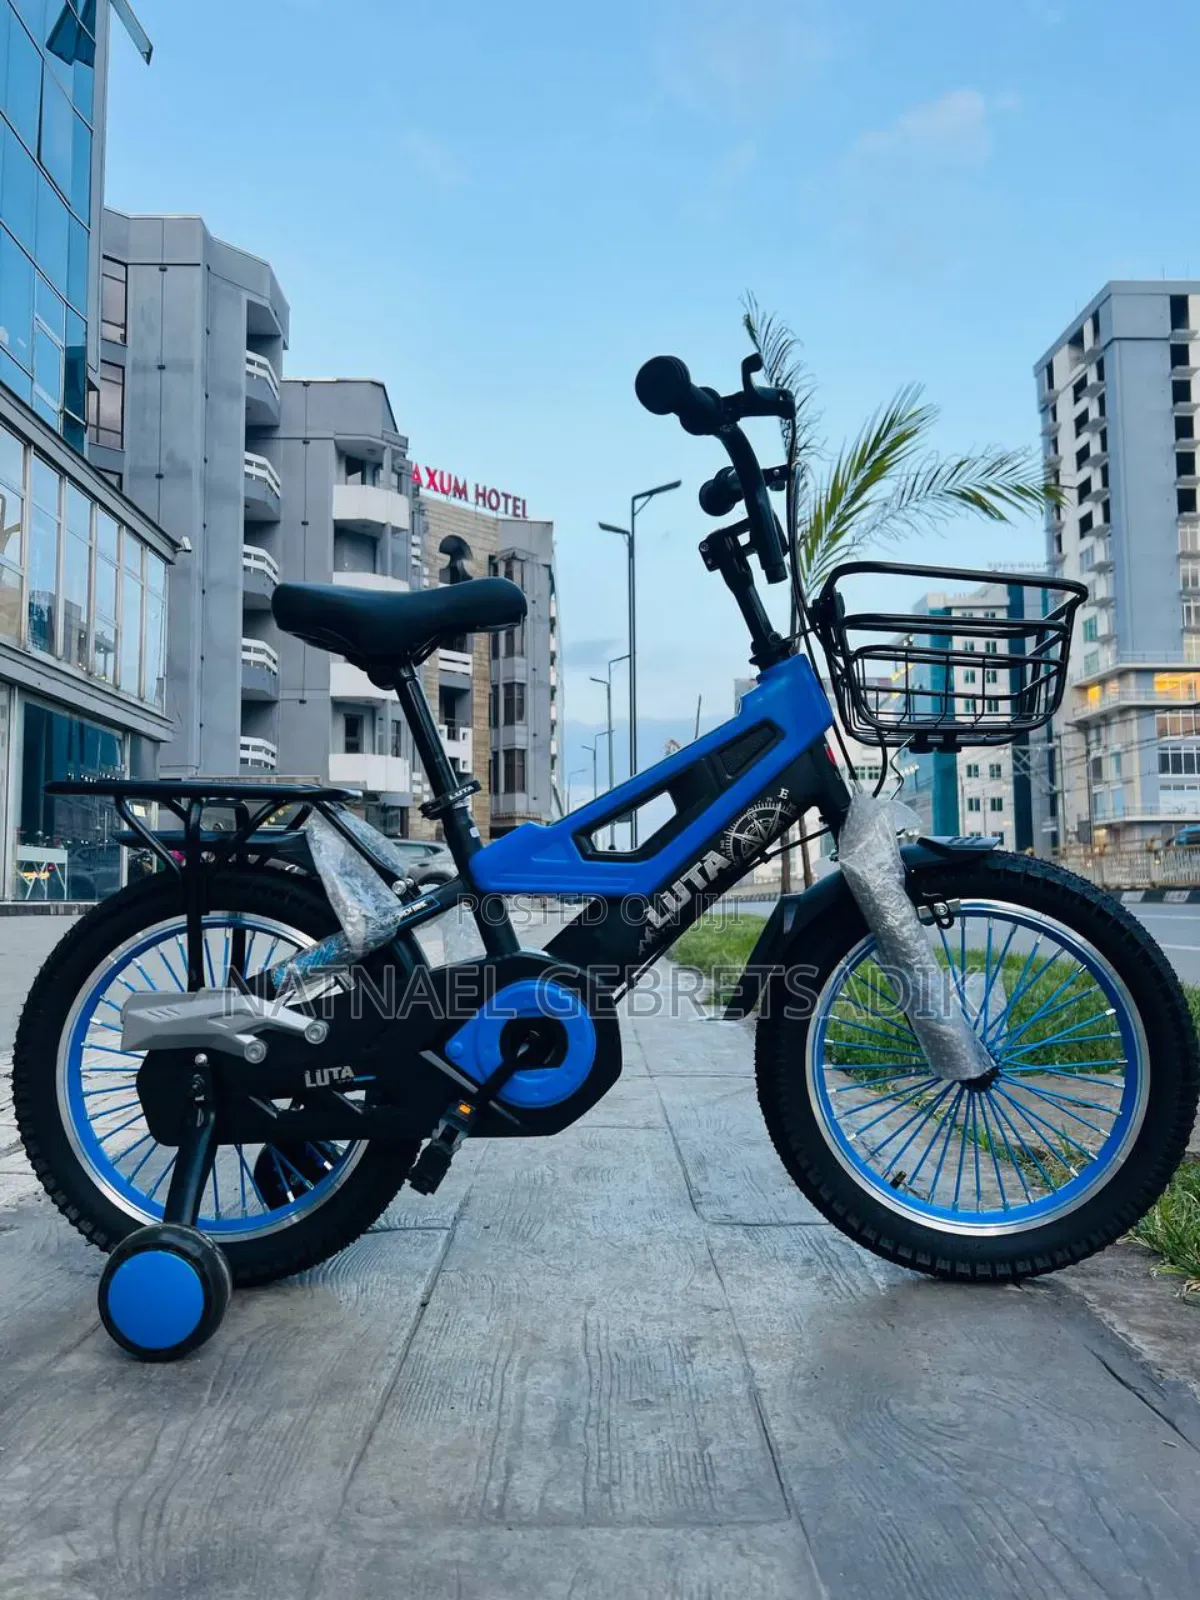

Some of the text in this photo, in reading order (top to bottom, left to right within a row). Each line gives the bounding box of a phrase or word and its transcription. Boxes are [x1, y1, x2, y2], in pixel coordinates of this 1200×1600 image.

[410, 461, 528, 519] AXUM HOTEL
[778, 787, 790, 800] E
[643, 850, 732, 929] LUTA
[304, 1065, 355, 1088] LUTA
